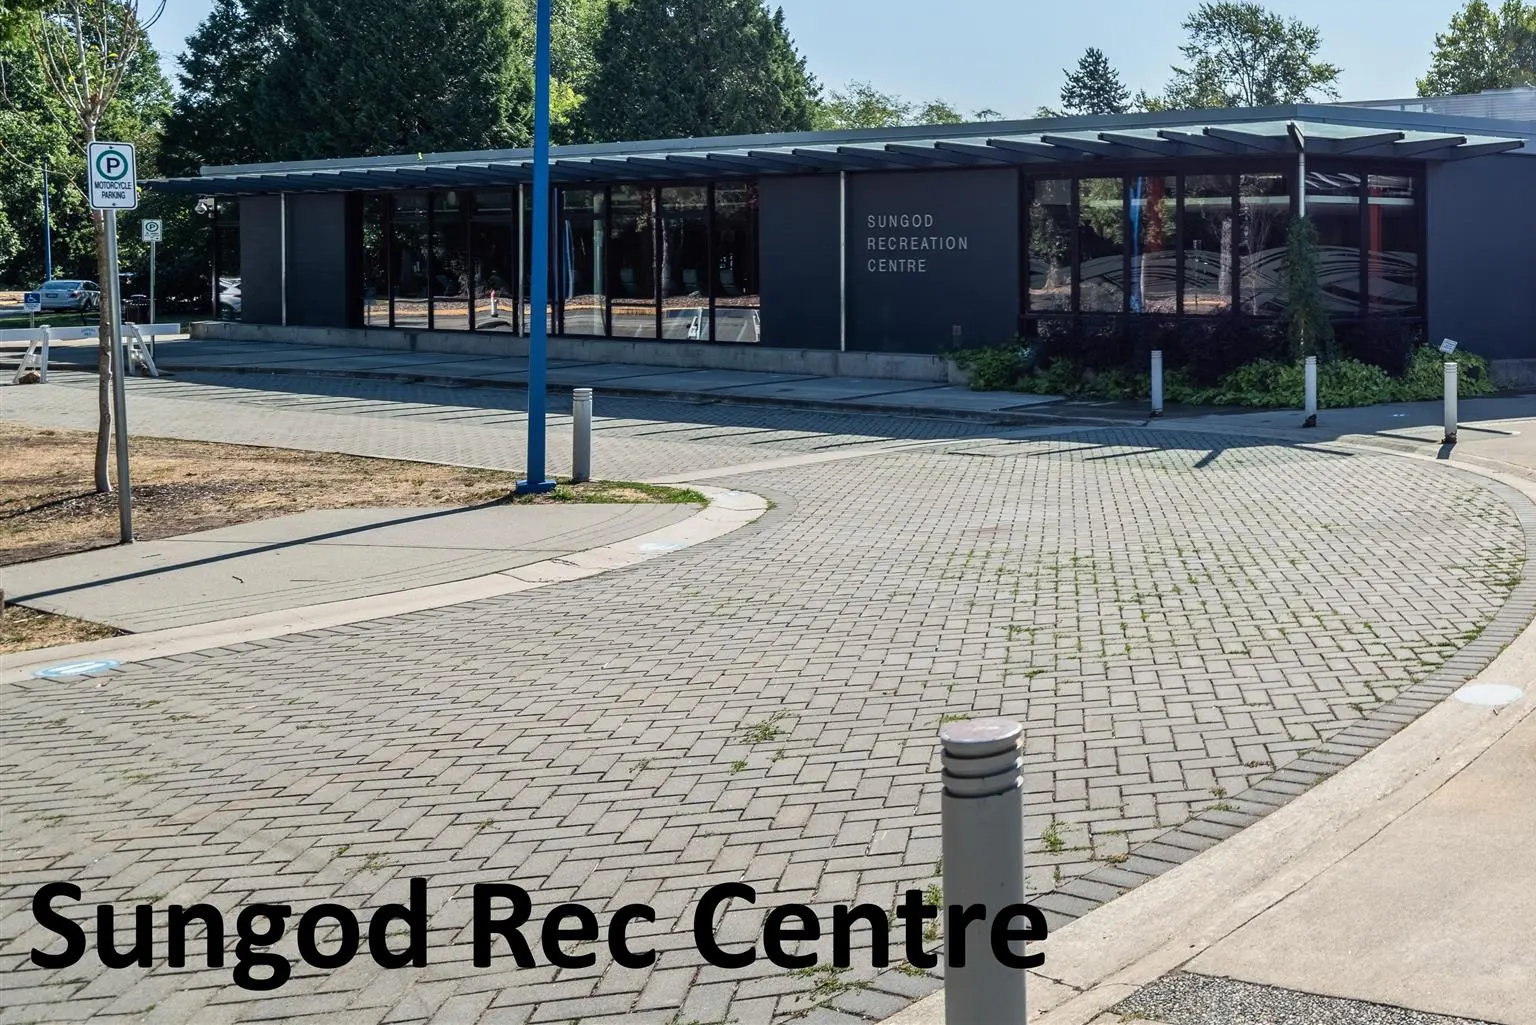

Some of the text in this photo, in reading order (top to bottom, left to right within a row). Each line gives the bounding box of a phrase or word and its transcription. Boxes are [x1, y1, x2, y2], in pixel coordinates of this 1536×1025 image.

[106, 157, 121, 174] P
[94, 181, 132, 190] MOTORCYCLE
[101, 191, 126, 200] PARKING
[867, 214, 934, 228] SUNGOD
[867, 236, 968, 250] RECREATION
[867, 258, 927, 273] CENTRE
